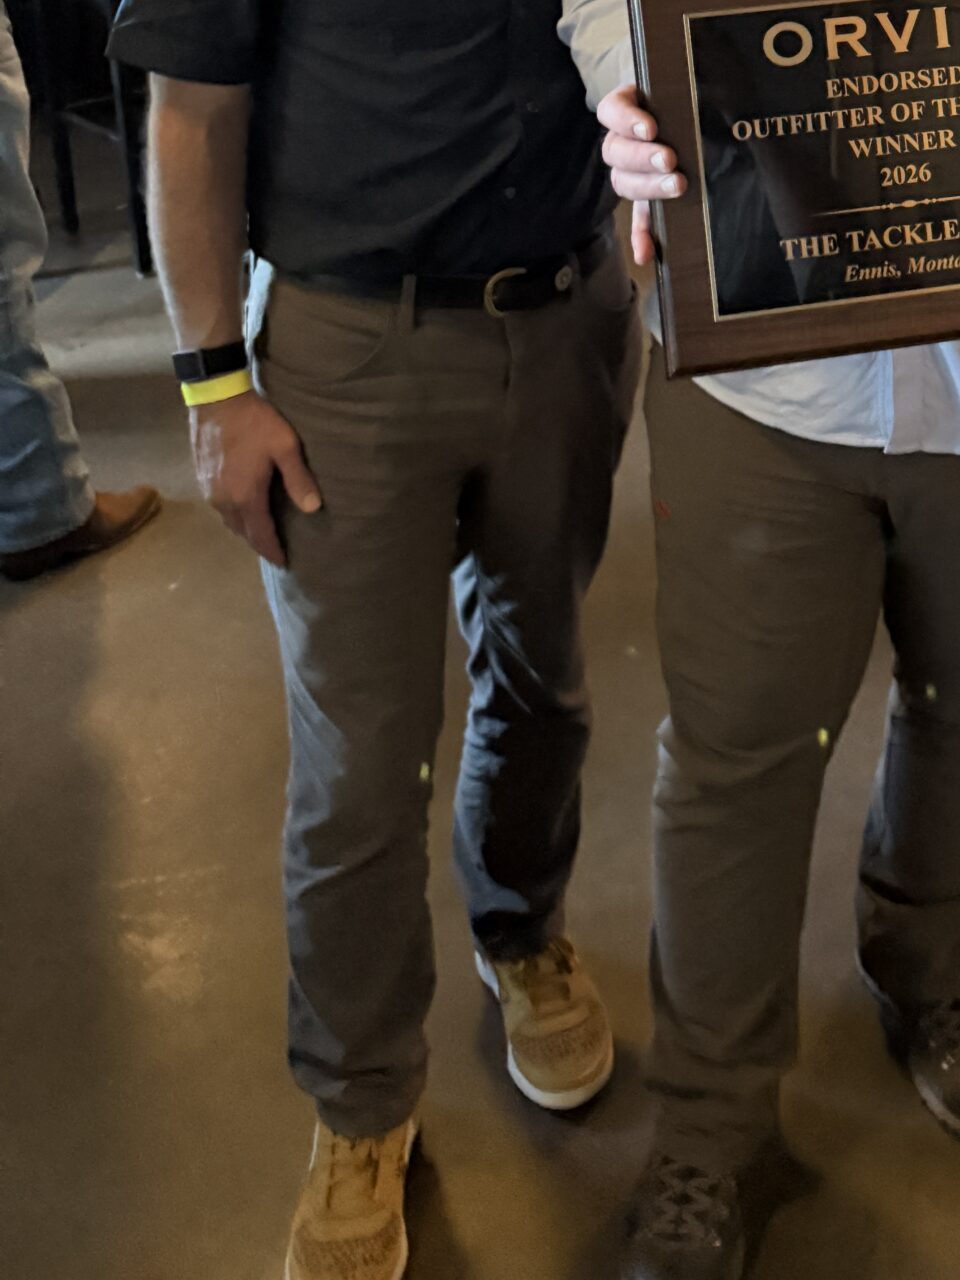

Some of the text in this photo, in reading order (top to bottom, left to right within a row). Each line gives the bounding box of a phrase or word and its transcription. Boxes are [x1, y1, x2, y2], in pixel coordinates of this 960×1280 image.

[732, 105, 885, 141] OUTFITTER
[890, 100, 926, 123] OF
[848, 129, 957, 158] WINNER
[880, 162, 932, 187] 2026
[779, 233, 840, 261] THE
[845, 218, 960, 253] TACKLE
[843, 260, 902, 282] Ennis,
